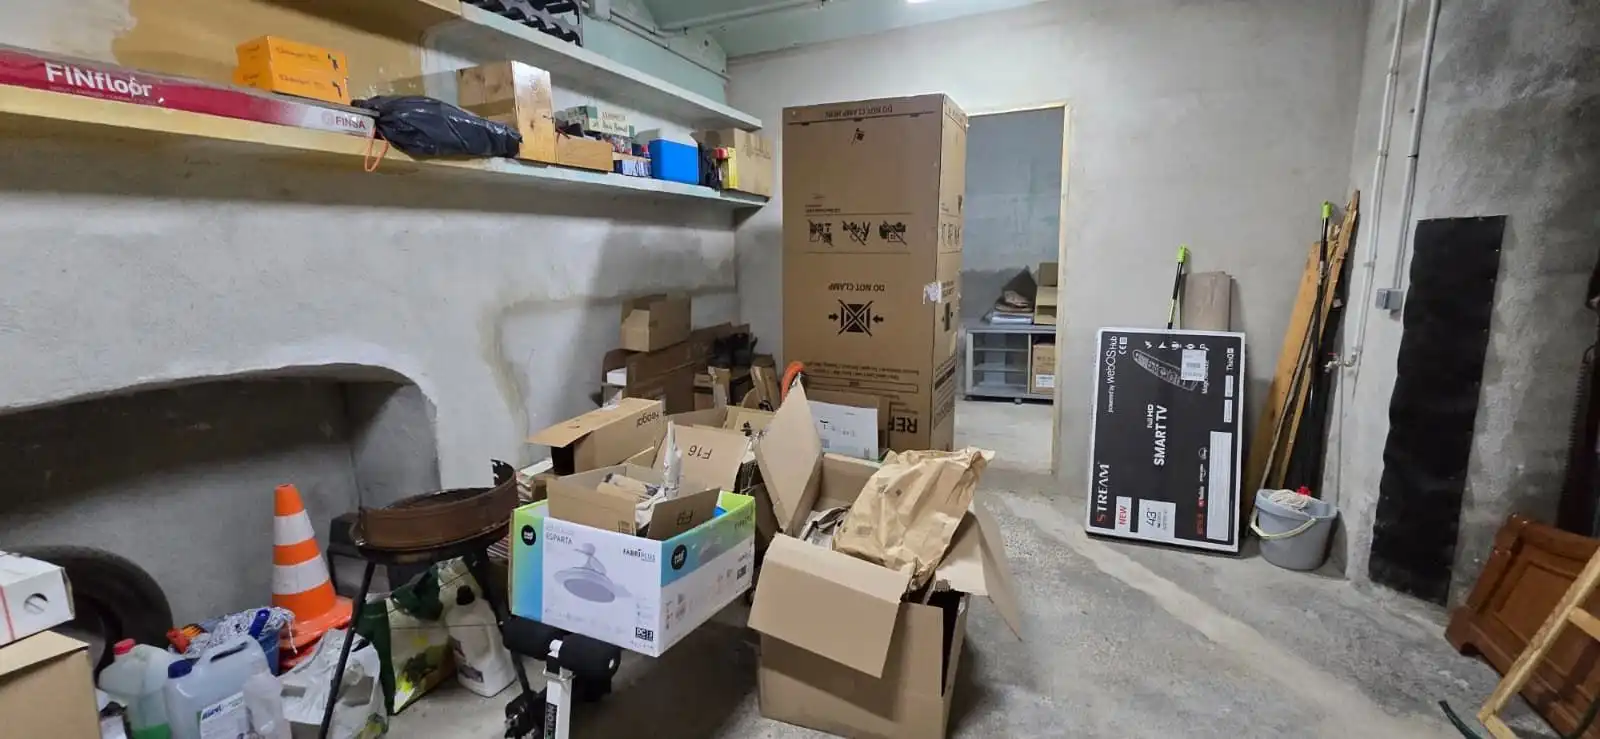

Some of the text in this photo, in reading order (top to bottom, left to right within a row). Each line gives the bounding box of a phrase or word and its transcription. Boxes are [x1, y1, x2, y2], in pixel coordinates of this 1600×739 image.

[44, 61, 153, 98] FINfloor
[335, 115, 366, 129] FINSA
[828, 282, 885, 292] DO NOT CLAMP
[1109, 335, 1118, 350] Hub
[1147, 404, 1154, 416] HD
[1153, 405, 1168, 466] SMART TV
[688, 445, 712, 460] F16
[1096, 463, 1110, 524] STREAM
[1118, 505, 1128, 526] NEW
